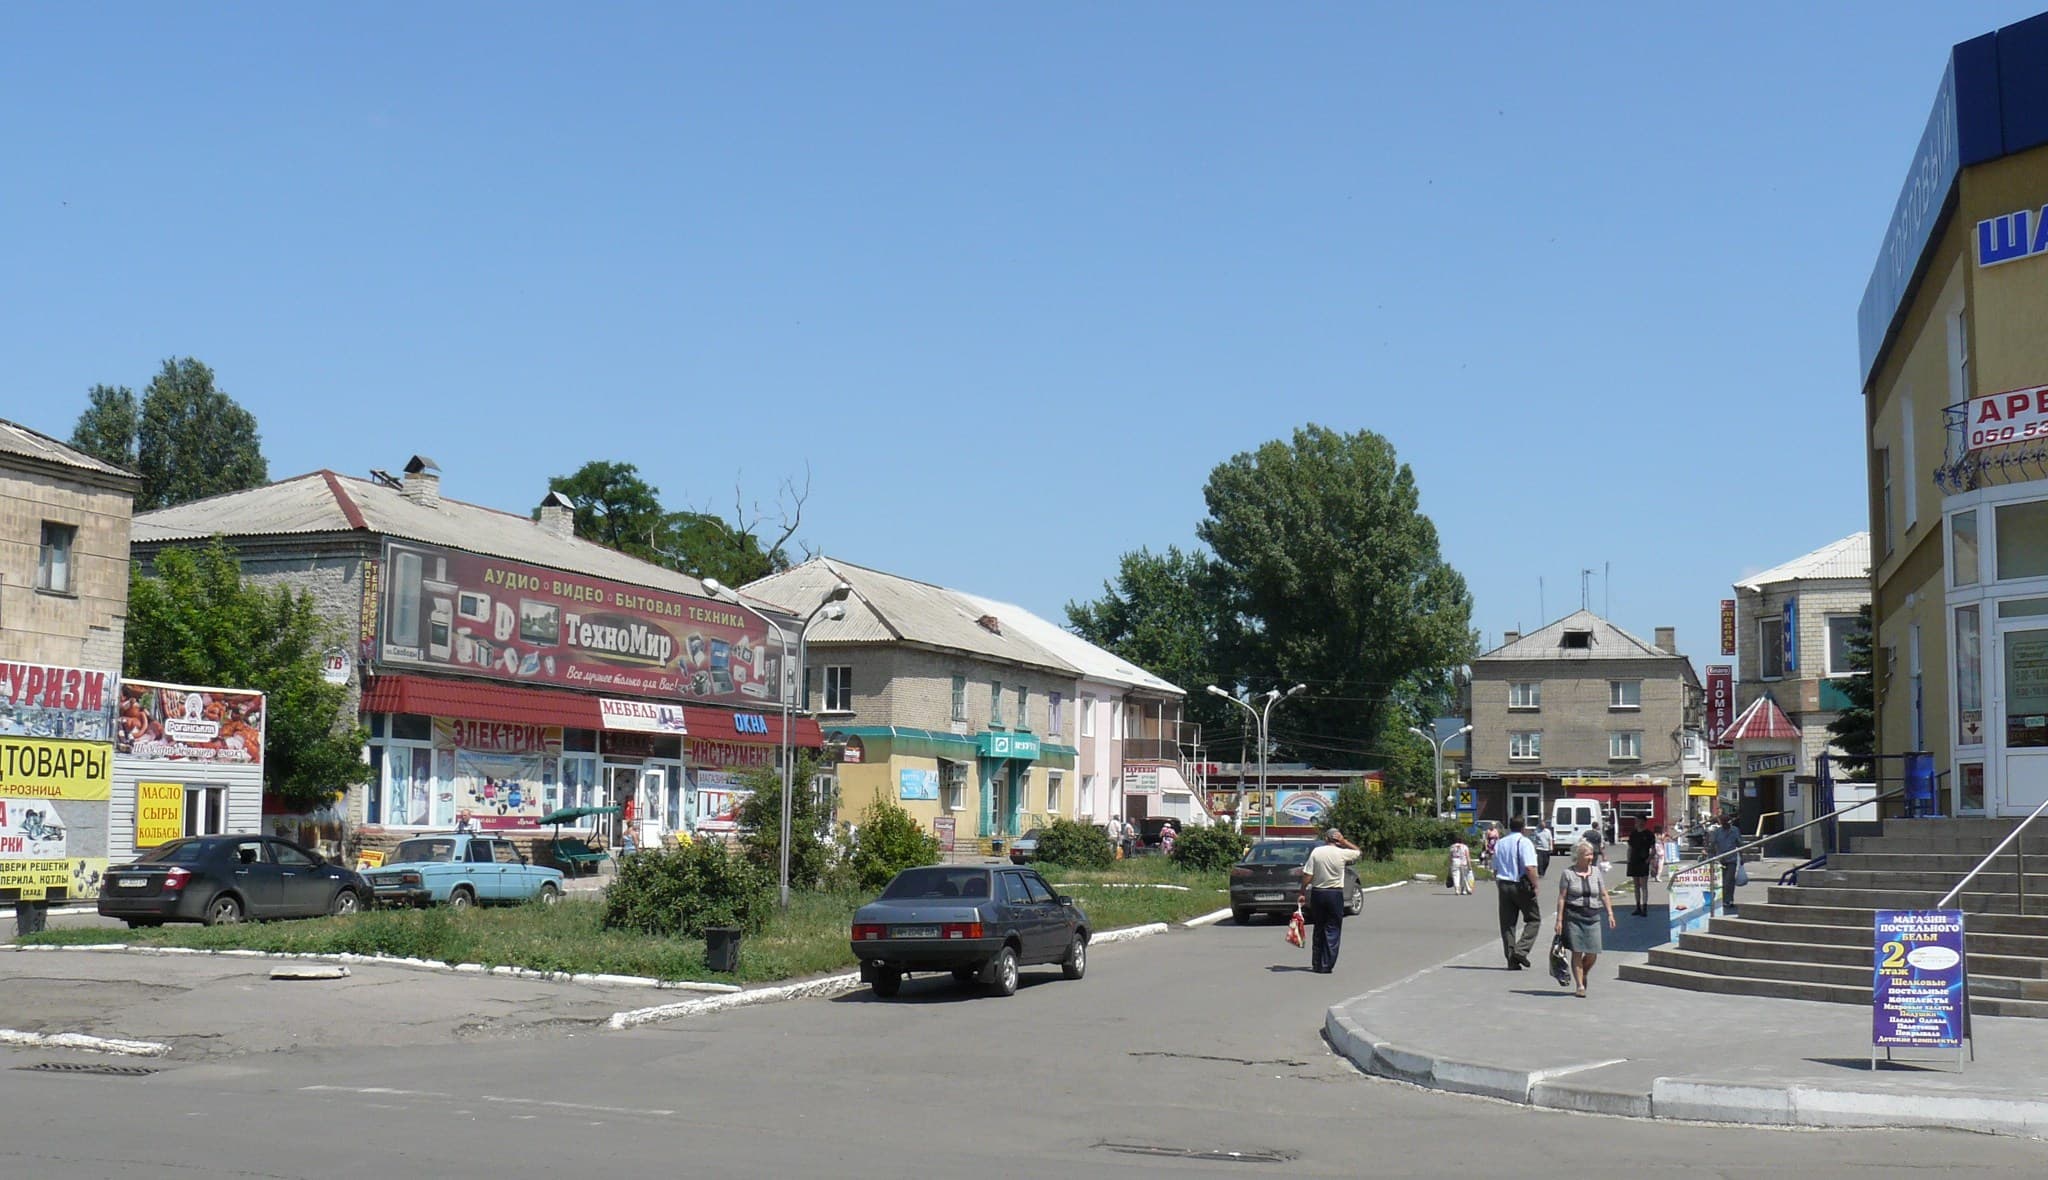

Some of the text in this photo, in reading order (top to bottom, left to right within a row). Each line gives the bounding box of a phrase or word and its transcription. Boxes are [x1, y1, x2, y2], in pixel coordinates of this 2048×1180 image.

[1972, 426, 2015, 445] 050
[484, 568, 745, 628] АУДИО ВИДЕО БЫТОВАЯ ТЕХНИКА
[565, 613, 671, 666] ТехноМир
[602, 700, 657, 719] МЕБЕЛЬ
[734, 713, 768, 734] ОКНА
[453, 719, 546, 750] ЭЛЕКТРИК
[692, 741, 770, 767] ИНСТРУМЕНТ
[1747, 756, 1795, 772] STANDART
[142, 787, 181, 799] МАСЛО
[143, 807, 178, 819] СЫРЫ
[139, 827, 180, 838] КОЛБАСЫ
[30, 861, 69, 871] РЕШЕТКИ
[40, 875, 69, 884] КОТЛЫ
[1893, 915, 1947, 924] МАГАЗИН
[1880, 924, 1960, 932] ПОСТЕЛЬНОГО
[1902, 933, 1938, 941] БЕЛЬЯ
[1882, 941, 1905, 967] 2
[1891, 978, 1947, 986] Шелковые
